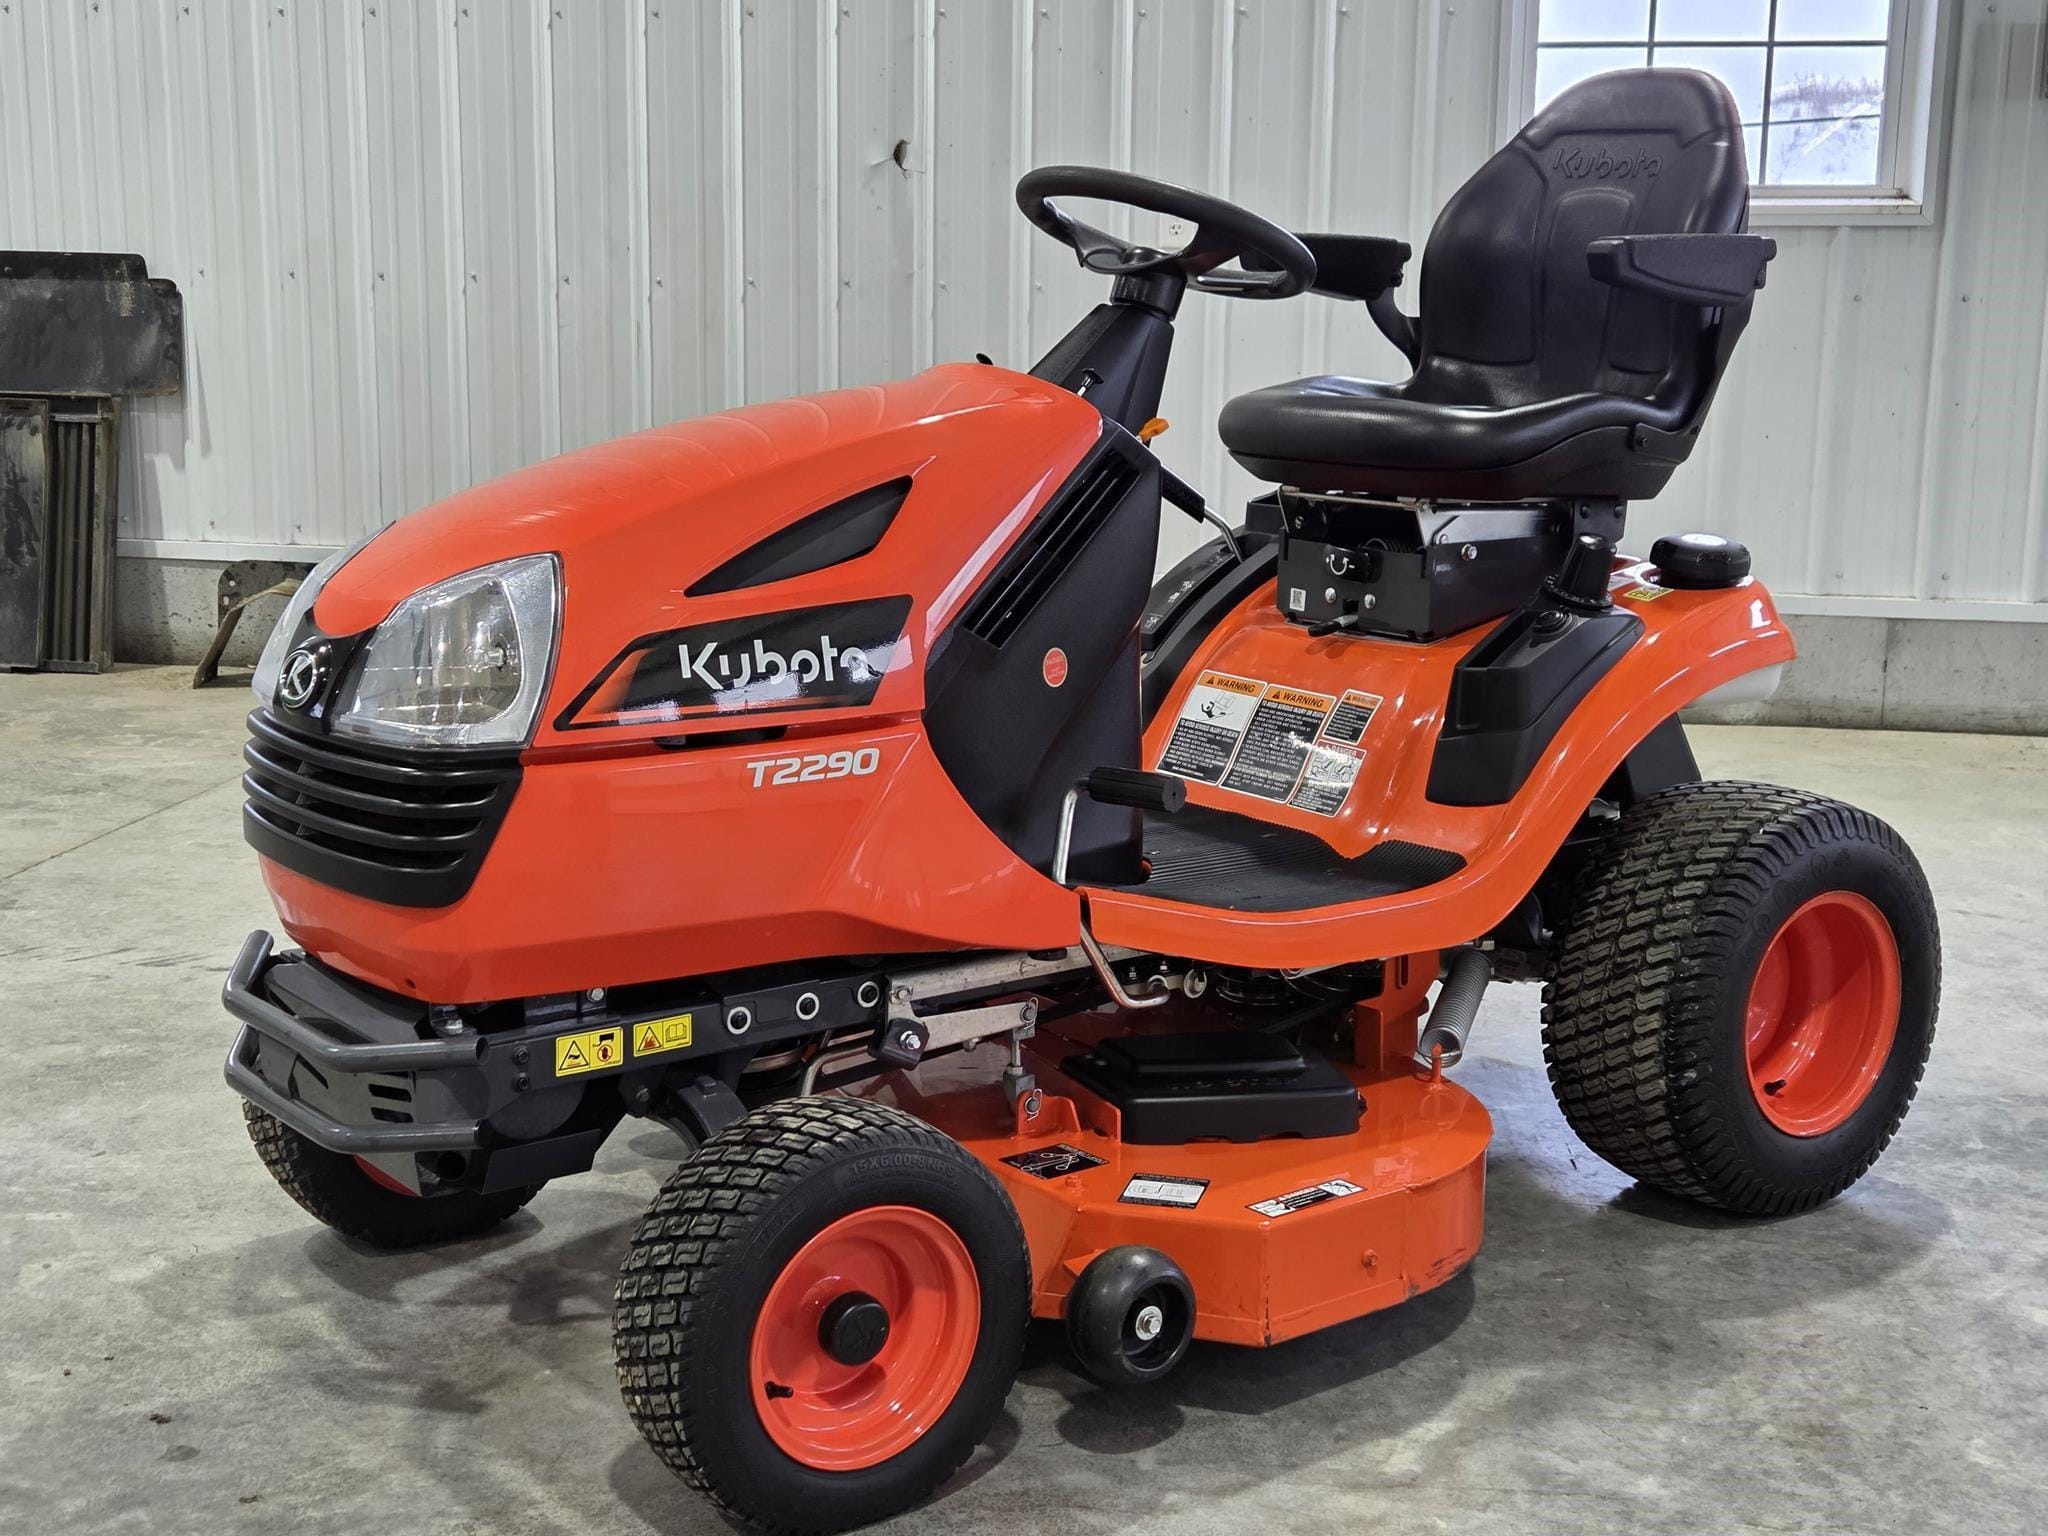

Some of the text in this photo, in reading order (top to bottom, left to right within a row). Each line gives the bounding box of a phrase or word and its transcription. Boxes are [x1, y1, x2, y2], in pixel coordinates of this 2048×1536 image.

[1552, 148, 1663, 179] Kubota
[678, 635, 870, 690] Kubota
[1216, 677, 1256, 693] WARNING
[1282, 691, 1324, 708] WARNING
[746, 747, 880, 788] T2290
